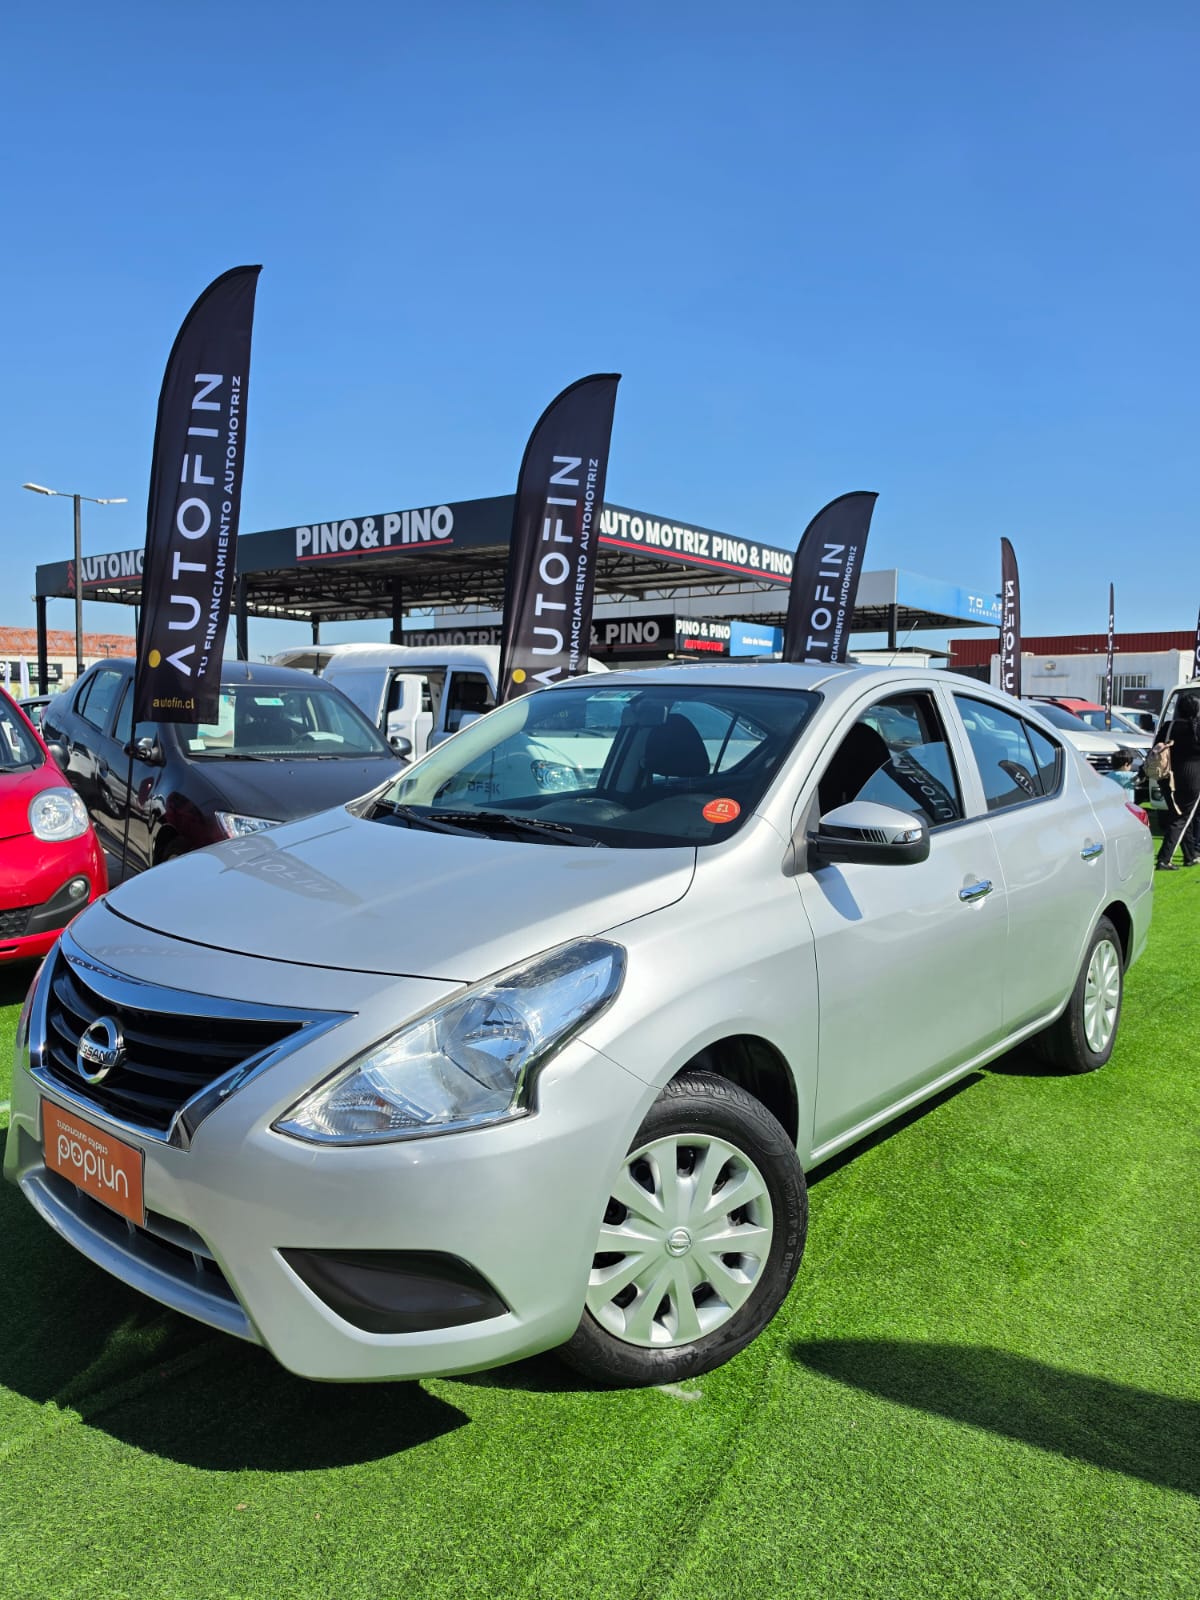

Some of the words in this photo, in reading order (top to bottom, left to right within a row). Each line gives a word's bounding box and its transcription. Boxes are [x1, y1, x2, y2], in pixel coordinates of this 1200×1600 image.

[165, 373, 223, 677] AUTOFIN
[197, 655, 209, 677] TU
[204, 501, 232, 651] FINANCIAMIENTO
[224, 375, 241, 494] AUTOMOTRIZ
[712, 535, 748, 565] PINO
[748, 546, 760, 567] &
[761, 549, 793, 575] PINO
[531, 455, 583, 687] AUTOFIN
[569, 554, 588, 671] FINANCIAMIENTO
[580, 458, 599, 550] AUTOMOTRIZ
[840, 545, 858, 607] AUTOMOTRIZ
[606, 621, 660, 644] PINO
[675, 619, 700, 636] PINO
[709, 623, 731, 639] PINO
[152, 696, 195, 710] autofin.cl
[57, 1134, 129, 1198] unidad
